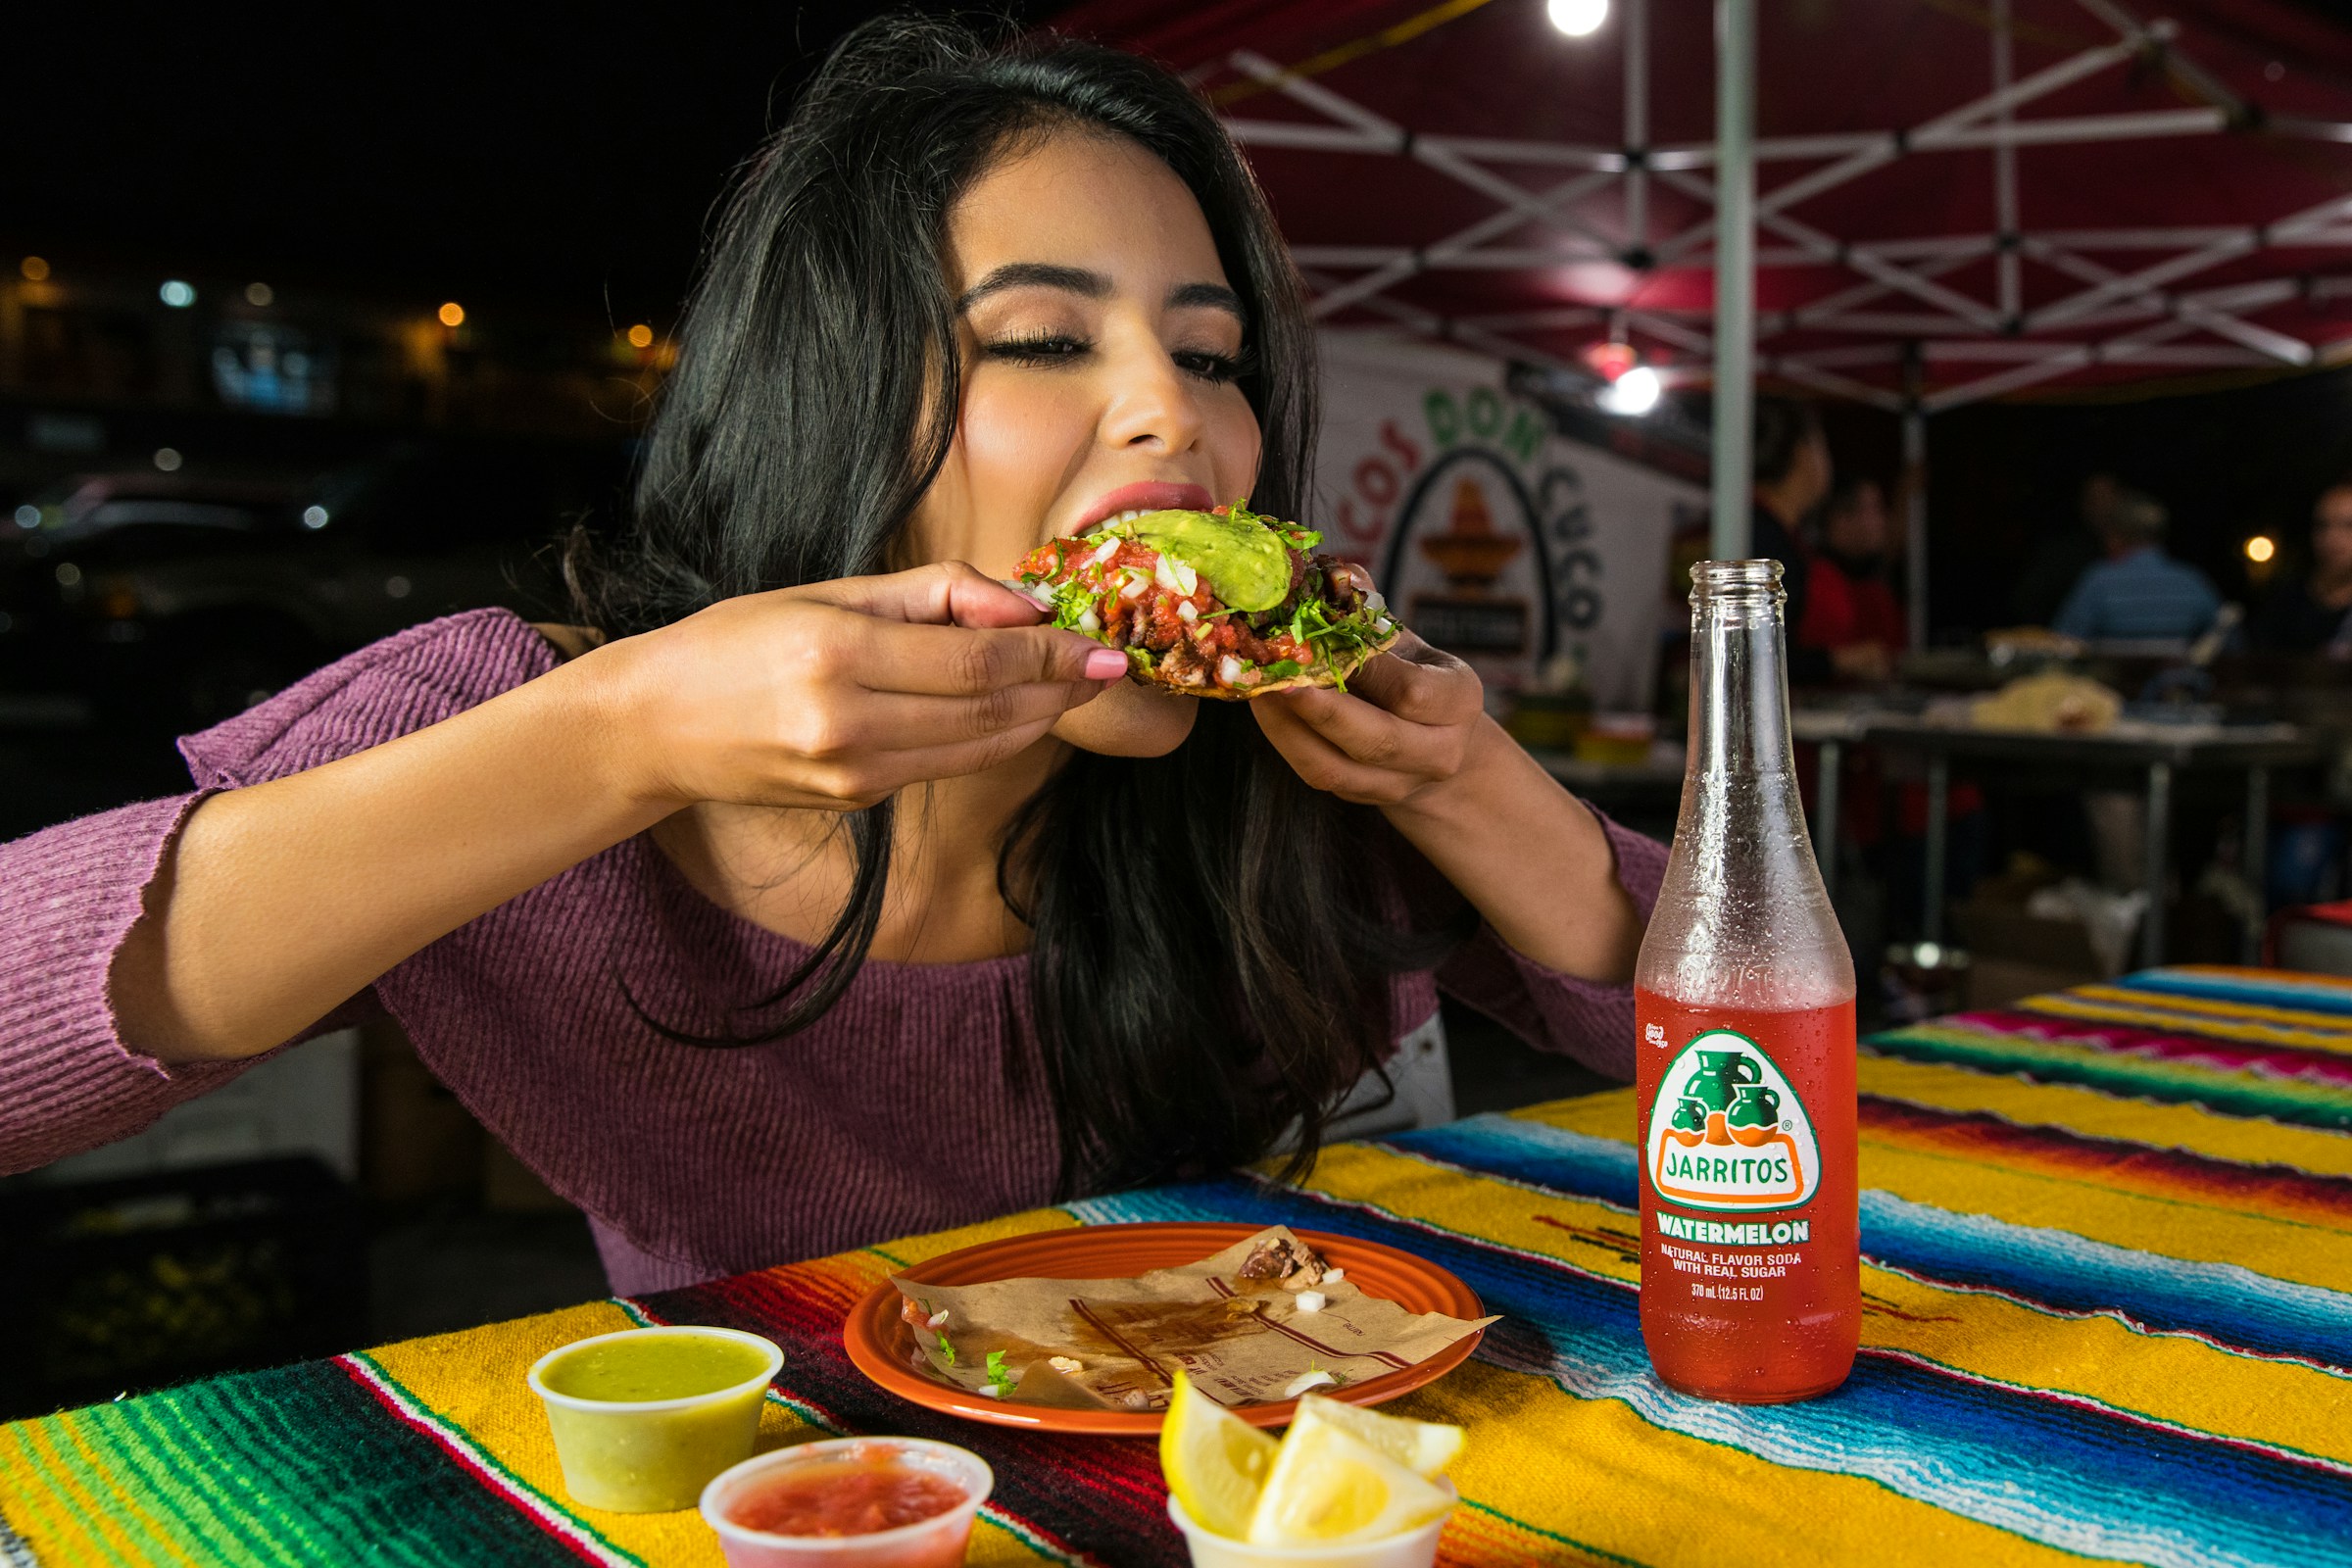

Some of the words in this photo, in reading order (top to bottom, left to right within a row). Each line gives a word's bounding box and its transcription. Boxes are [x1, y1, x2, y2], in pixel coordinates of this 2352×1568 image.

[1425, 388, 1543, 460] DON
[1666, 1152, 1788, 1184] JARRITOS
[1656, 1210, 1810, 1246] WATERMELON
[1661, 1243, 1708, 1263] NATURAL
[1712, 1253, 1763, 1266] FLAVOR
[1767, 1252, 1802, 1265] SODA
[1672, 1258, 1701, 1274] WITH
[1704, 1264, 1739, 1278] REAL
[1740, 1266, 1787, 1278] SUGAR
[1691, 1283, 1704, 1298] 370
[1718, 1284, 1739, 1300] (12.5
[1749, 1285, 1764, 1301] OZ)
